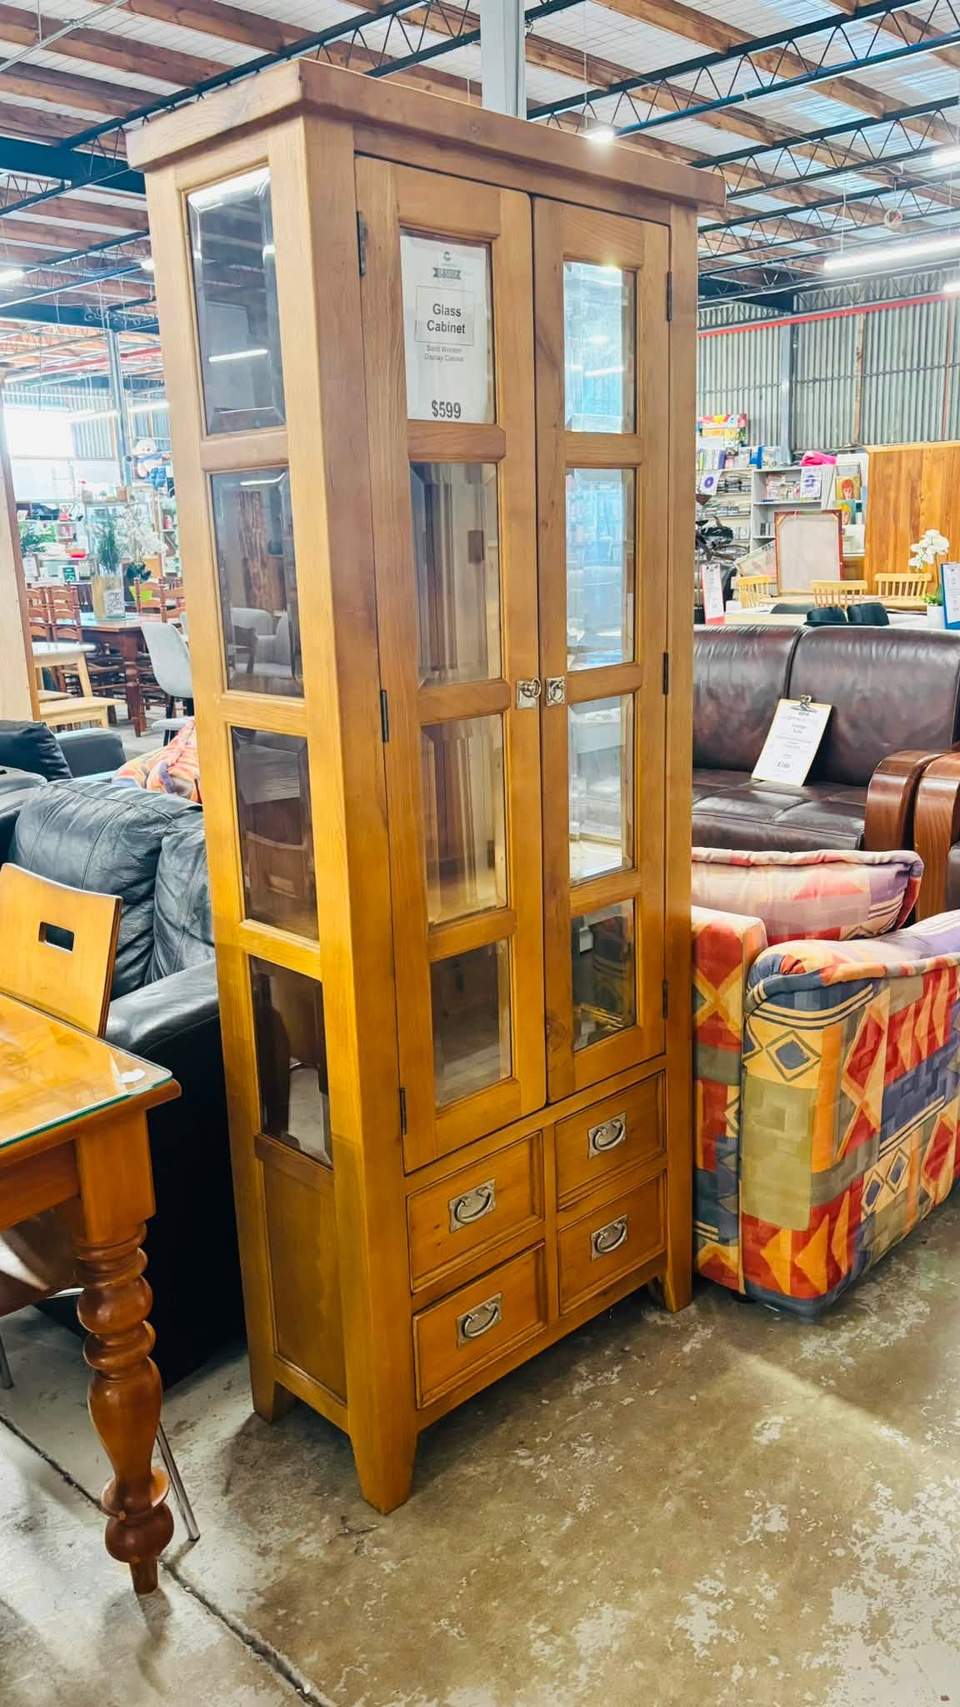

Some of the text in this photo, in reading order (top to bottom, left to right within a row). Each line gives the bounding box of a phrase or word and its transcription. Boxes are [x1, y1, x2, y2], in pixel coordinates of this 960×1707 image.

[432, 303, 462, 317] Glass
[426, 319, 466, 334] Cabinet
[431, 400, 462, 419] $599
